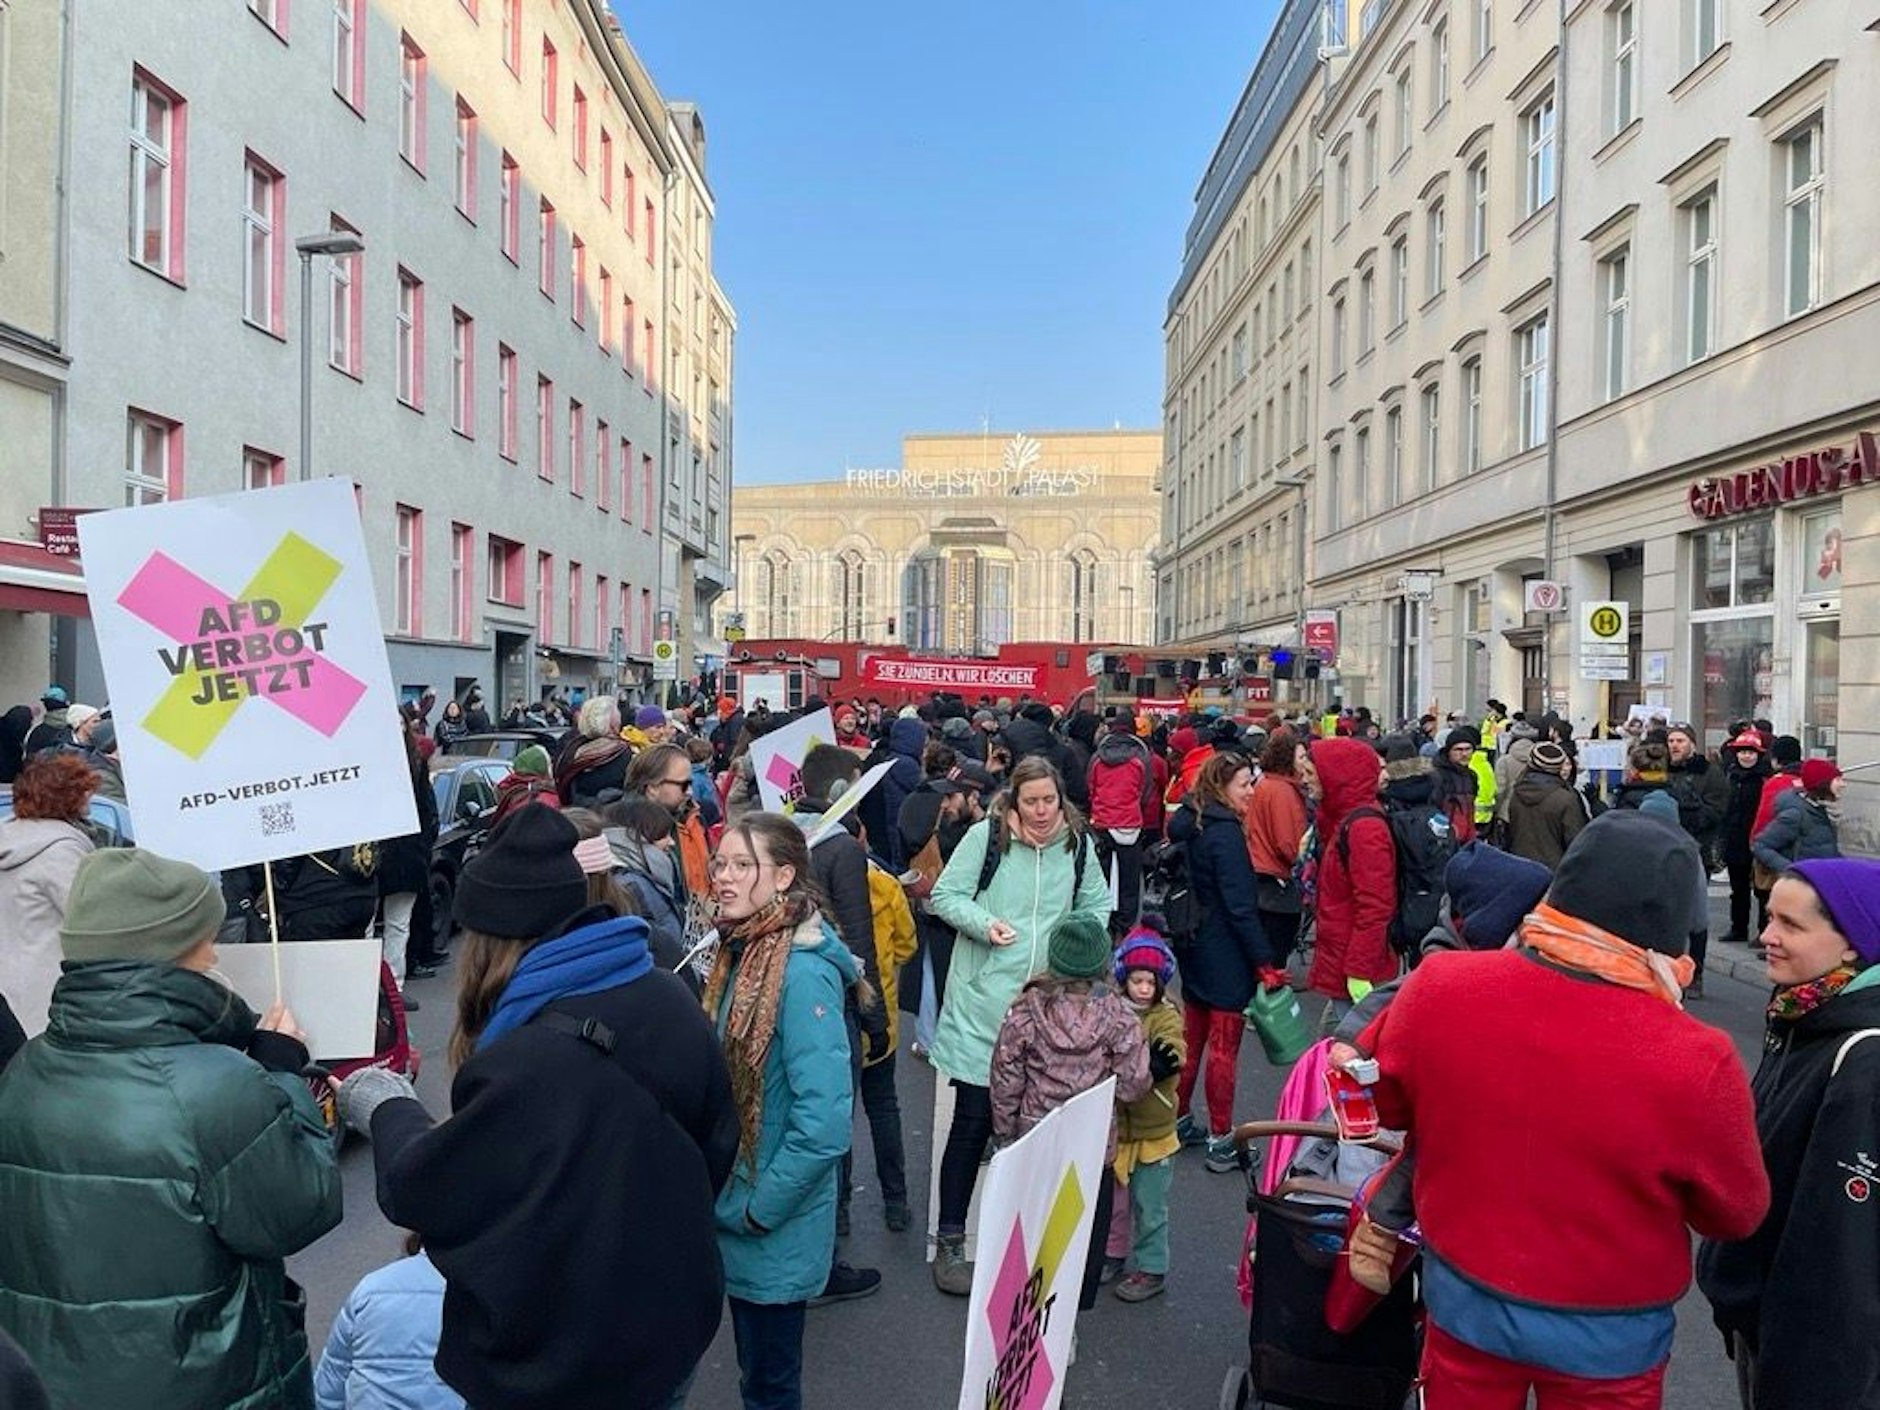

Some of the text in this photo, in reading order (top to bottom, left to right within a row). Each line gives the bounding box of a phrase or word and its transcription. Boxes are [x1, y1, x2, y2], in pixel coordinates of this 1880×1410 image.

[1027, 465, 1098, 487] PALAST
[199, 599, 282, 637] AFD
[1599, 614, 1614, 630] H
[158, 623, 328, 676] VERBOT
[191, 660, 314, 705] JETZT
[878, 664, 896, 677] SIE
[957, 669, 980, 683] WIR
[981, 668, 1033, 685] LÖSCHEN
[1247, 688, 1269, 699] FIT
[179, 765, 362, 811] AFD-VERBOT.JETZT
[1006, 1267, 1043, 1346] AFD
